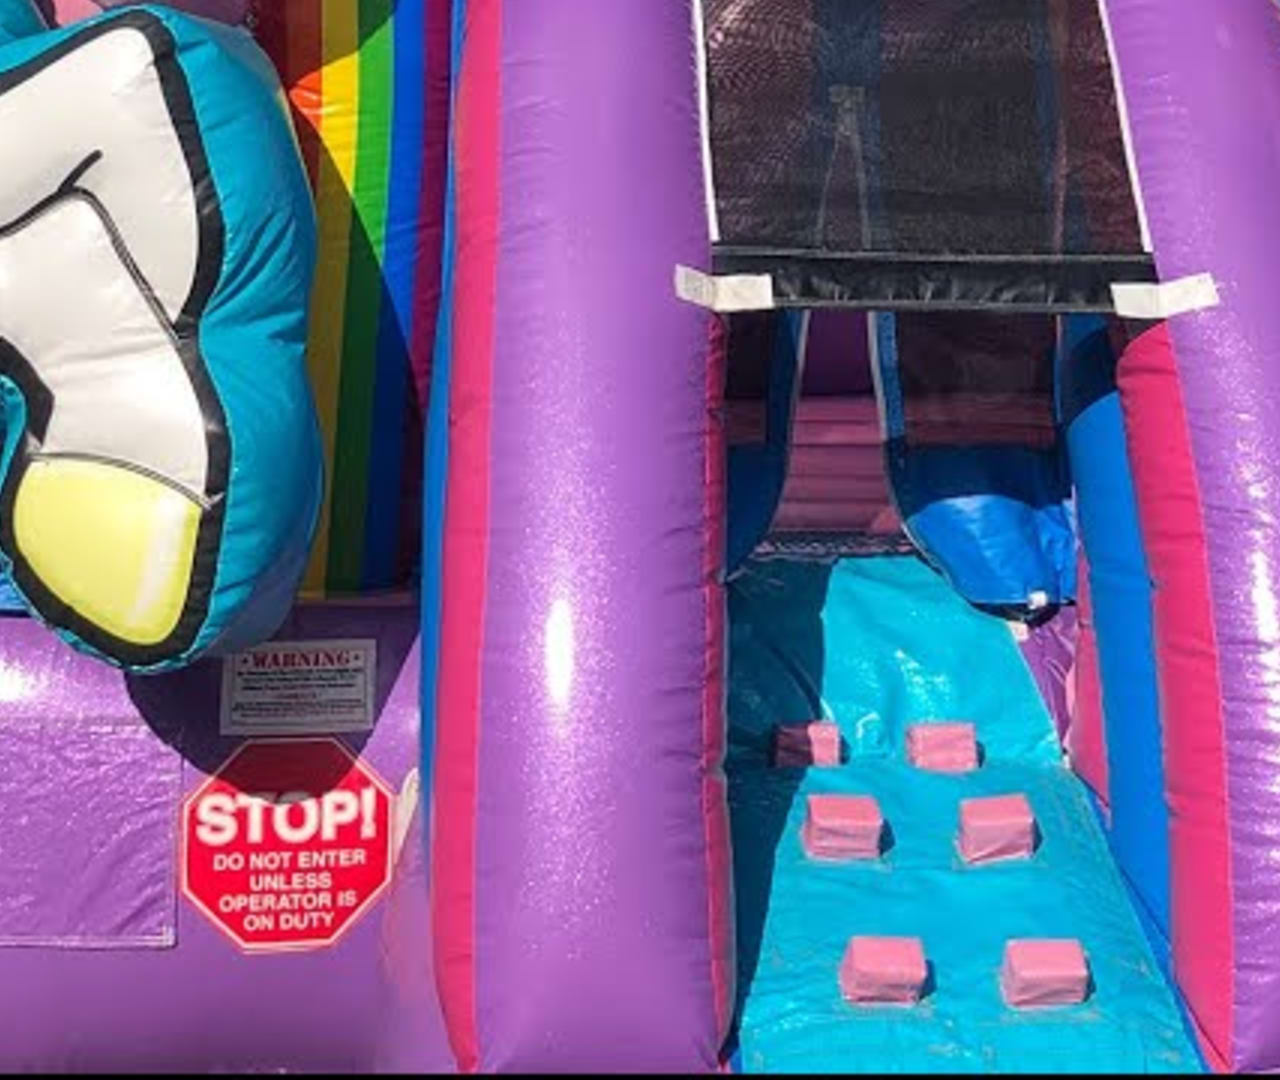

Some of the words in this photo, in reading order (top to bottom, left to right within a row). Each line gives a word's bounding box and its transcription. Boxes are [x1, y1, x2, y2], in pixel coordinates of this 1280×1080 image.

[252, 649, 351, 669] WARNING
[195, 787, 377, 847] STOP!
[212, 852, 245, 871] DO
[249, 851, 293, 870] NOT
[297, 848, 367, 869] ENTER
[249, 870, 332, 892] UNLESS
[218, 891, 332, 913] OPERATOR
[337, 889, 357, 907] IS
[243, 914, 274, 932] ON
[279, 911, 334, 931] DUTY
